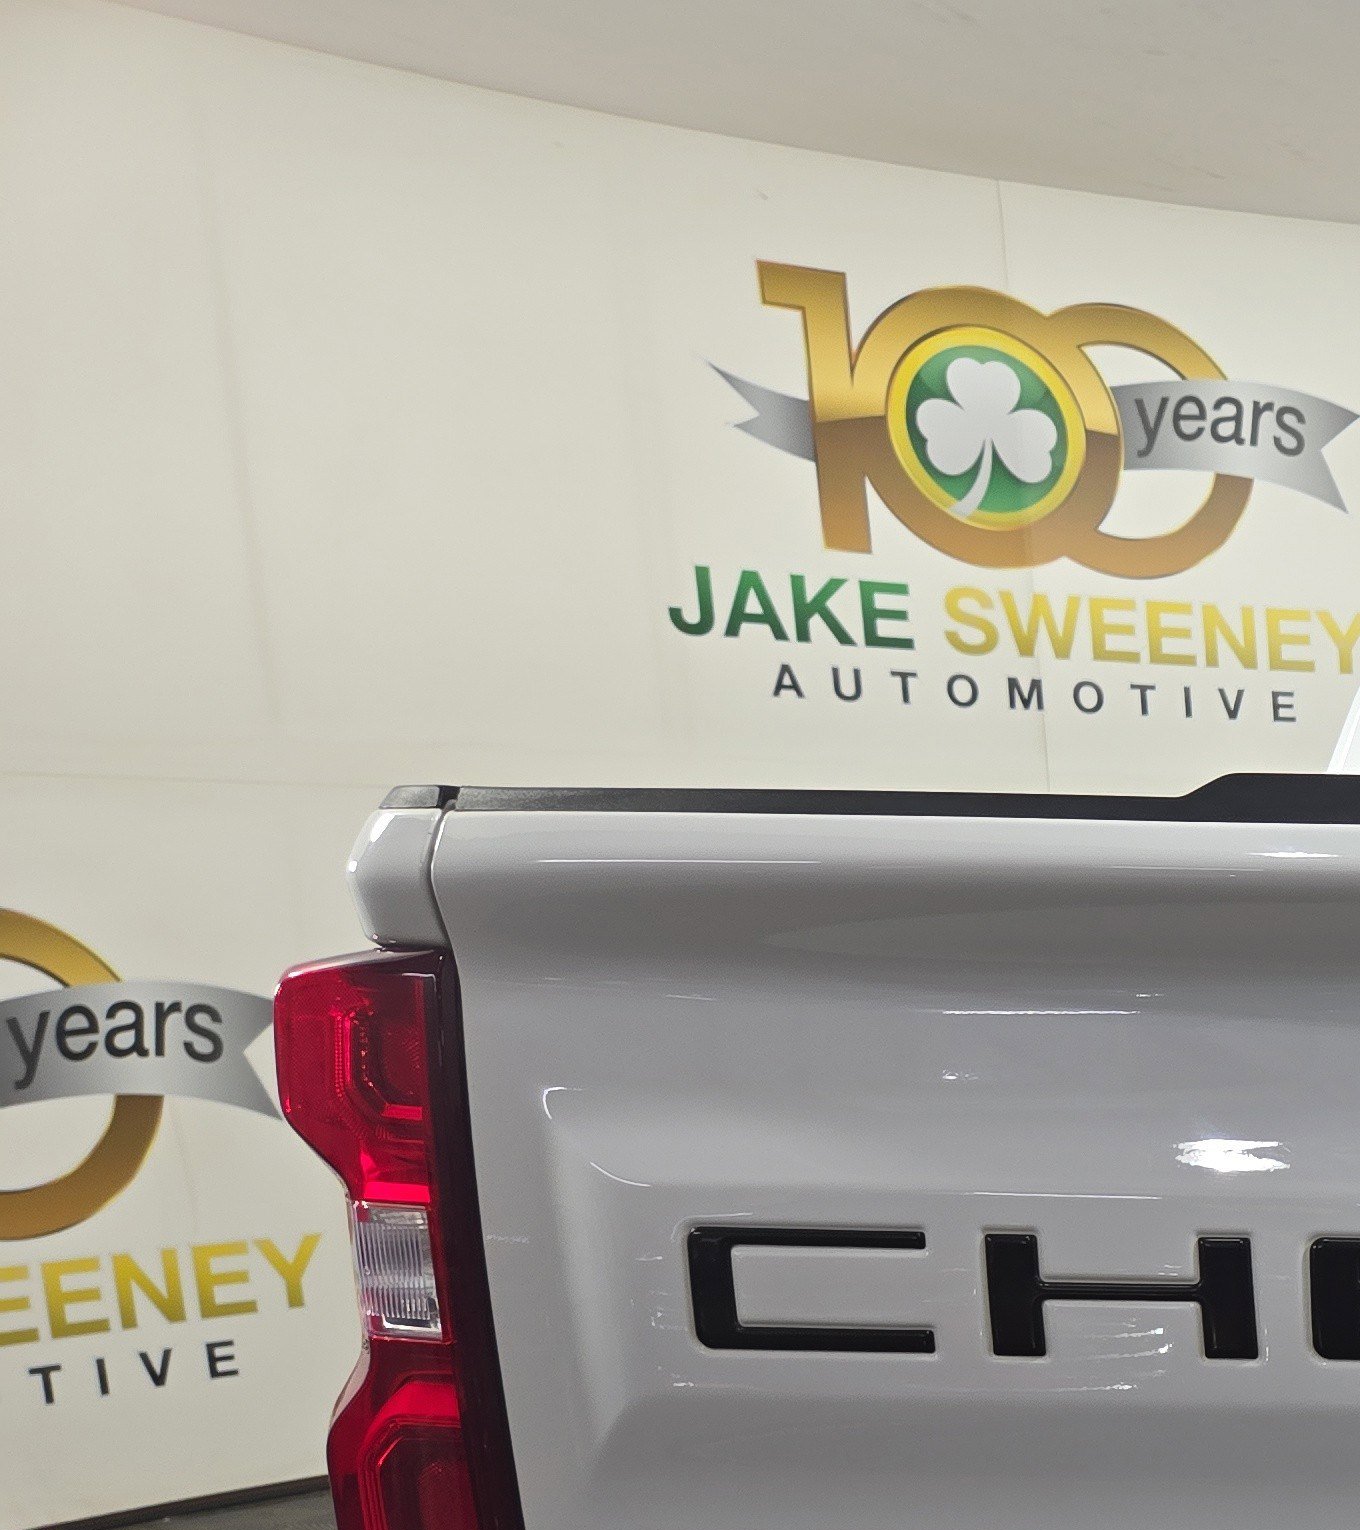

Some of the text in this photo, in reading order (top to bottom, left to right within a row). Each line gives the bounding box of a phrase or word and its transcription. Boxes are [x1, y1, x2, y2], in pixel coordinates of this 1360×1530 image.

[1135, 393, 1307, 457] years
[668, 564, 916, 650] JAKE
[773, 663, 1298, 723] AUTOMOTIVE
[4, 999, 224, 1091] years
[28, 1339, 239, 1404] TIVE
